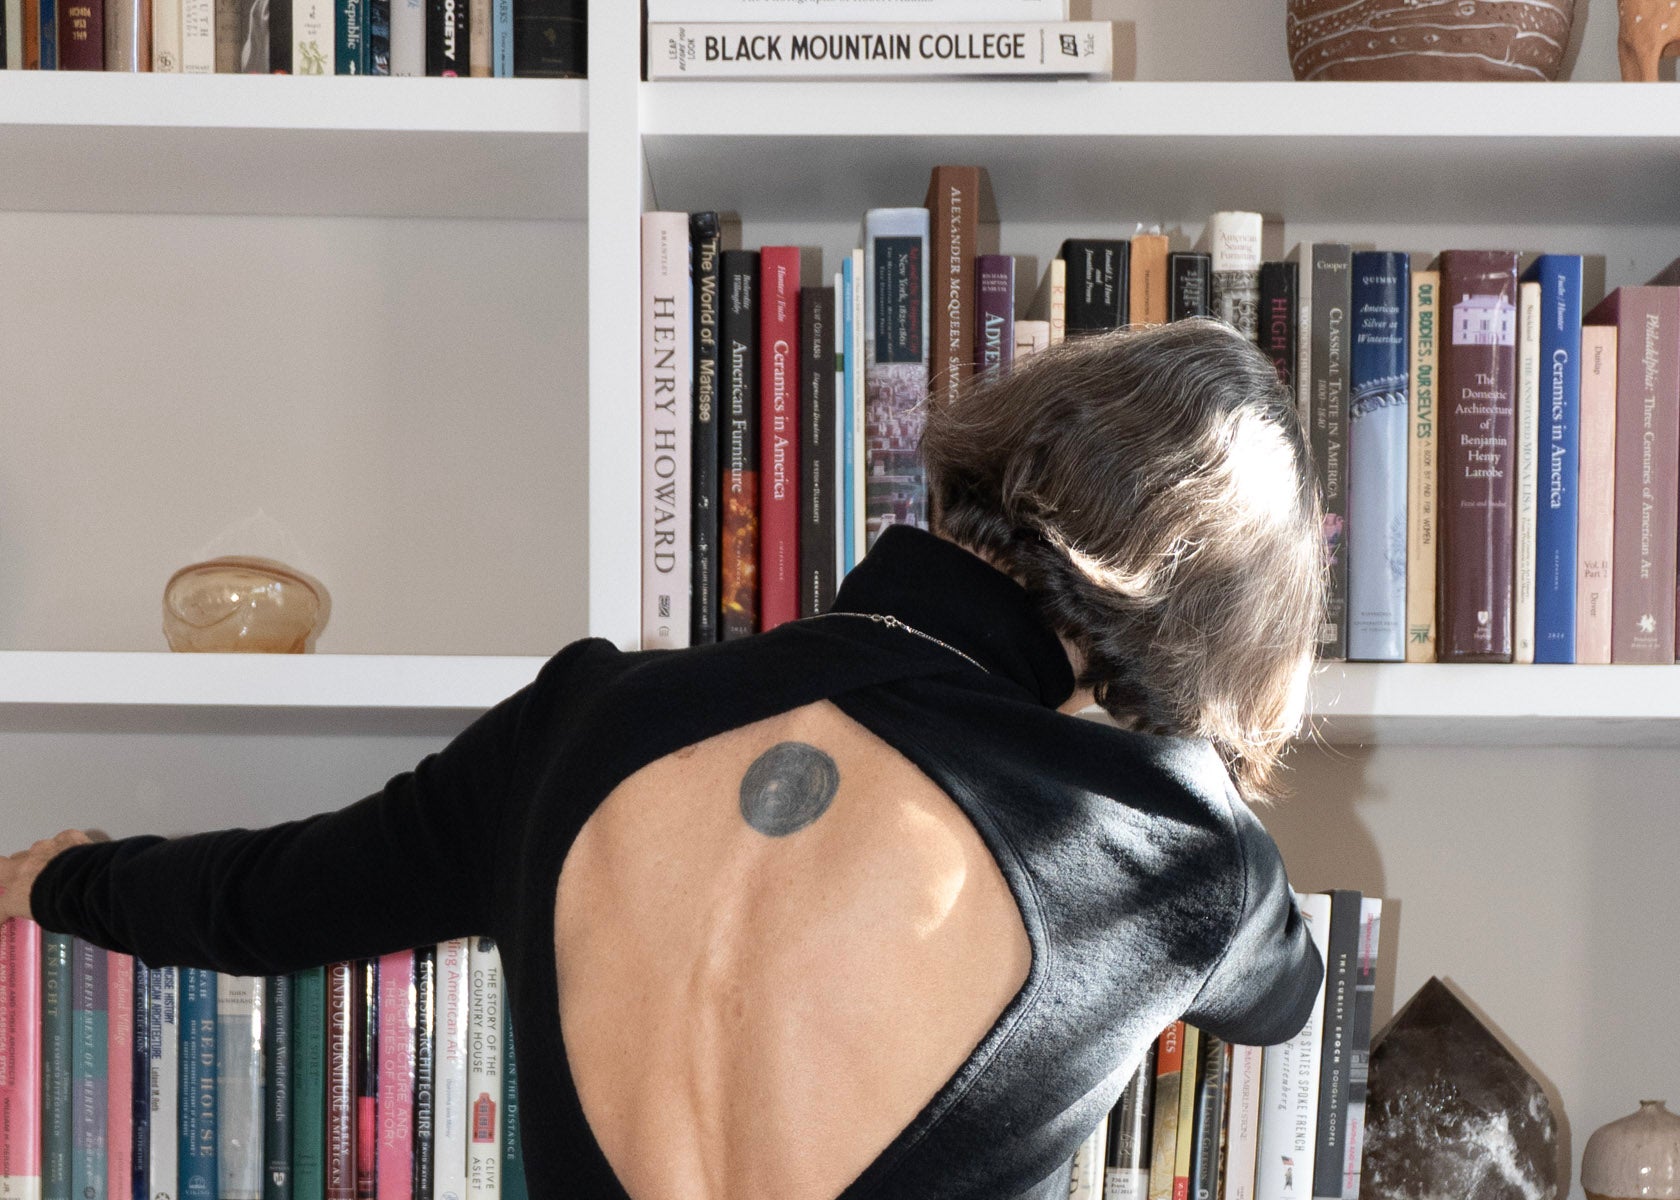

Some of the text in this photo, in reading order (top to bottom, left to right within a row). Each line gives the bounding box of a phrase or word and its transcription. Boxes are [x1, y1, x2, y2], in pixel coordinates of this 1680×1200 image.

[705, 35, 783, 62] BLACK
[791, 34, 911, 61] MOUNTAIN
[918, 33, 1025, 60] COLLEGE
[949, 186, 962, 273] ALEXANDER
[898, 254, 908, 275] New
[1316, 260, 1348, 273] Cooper
[698, 239, 717, 422] The World of Matisse
[1271, 298, 1287, 350] HIGH
[1415, 284, 1433, 439] OUR BODIES, OURSELVES
[1462, 387, 1508, 400] Domestic
[1475, 373, 1495, 385] The
[653, 296, 677, 573] HENRY HOWARD
[731, 340, 748, 493] American Furniture
[772, 340, 789, 500] Ceramics in America
[1327, 421, 1340, 435] IN
[1454, 403, 1512, 416] Architecture
[1460, 434, 1507, 449] Benjamin
[1479, 418, 1492, 430] of
[1549, 349, 1568, 509] Ceramics in America
[1464, 466, 1504, 478] Latrobe
[1468, 449, 1501, 465] Henry
[1519, 441, 1532, 481] MONA
[1640, 314, 1659, 579] Philadelphia: Three Centuries of American Art
[1421, 517, 1431, 545] WOMEN
[1519, 484, 1531, 513] LISA
[1589, 592, 1600, 617] Dover
[47, 944, 58, 1017] KNIGHT
[84, 975, 93, 1047] REFINEMENT
[163, 991, 174, 1024] HISTORY
[151, 1003, 163, 1060] ARCHITECTURE
[446, 970, 461, 1061] American Art
[472, 970, 484, 1074] COUNTRY HOUSE
[485, 967, 497, 1077] THE STORY OF THE
[275, 1005, 287, 1122] into the World Goods
[331, 1034, 350, 1112] FURNITURE
[384, 978, 395, 1149] THE SITES HISTORY
[396, 987, 408, 1140] ARCHITECTURE AND
[418, 1027, 431, 1138] ARCHITECTURE
[1328, 954, 1347, 1147] THE CUBIST EPOCH DOUGLAS COOPER
[83, 1071, 93, 1122] AMERICA
[199, 1019, 215, 1157] RED HOUSE
[1293, 1040, 1312, 1152] STATES SPOKE FRENCH
[332, 1115, 341, 1184] AMERICAN
[471, 1156, 482, 1190] ASLET
[485, 1157, 496, 1190] CLIVE
